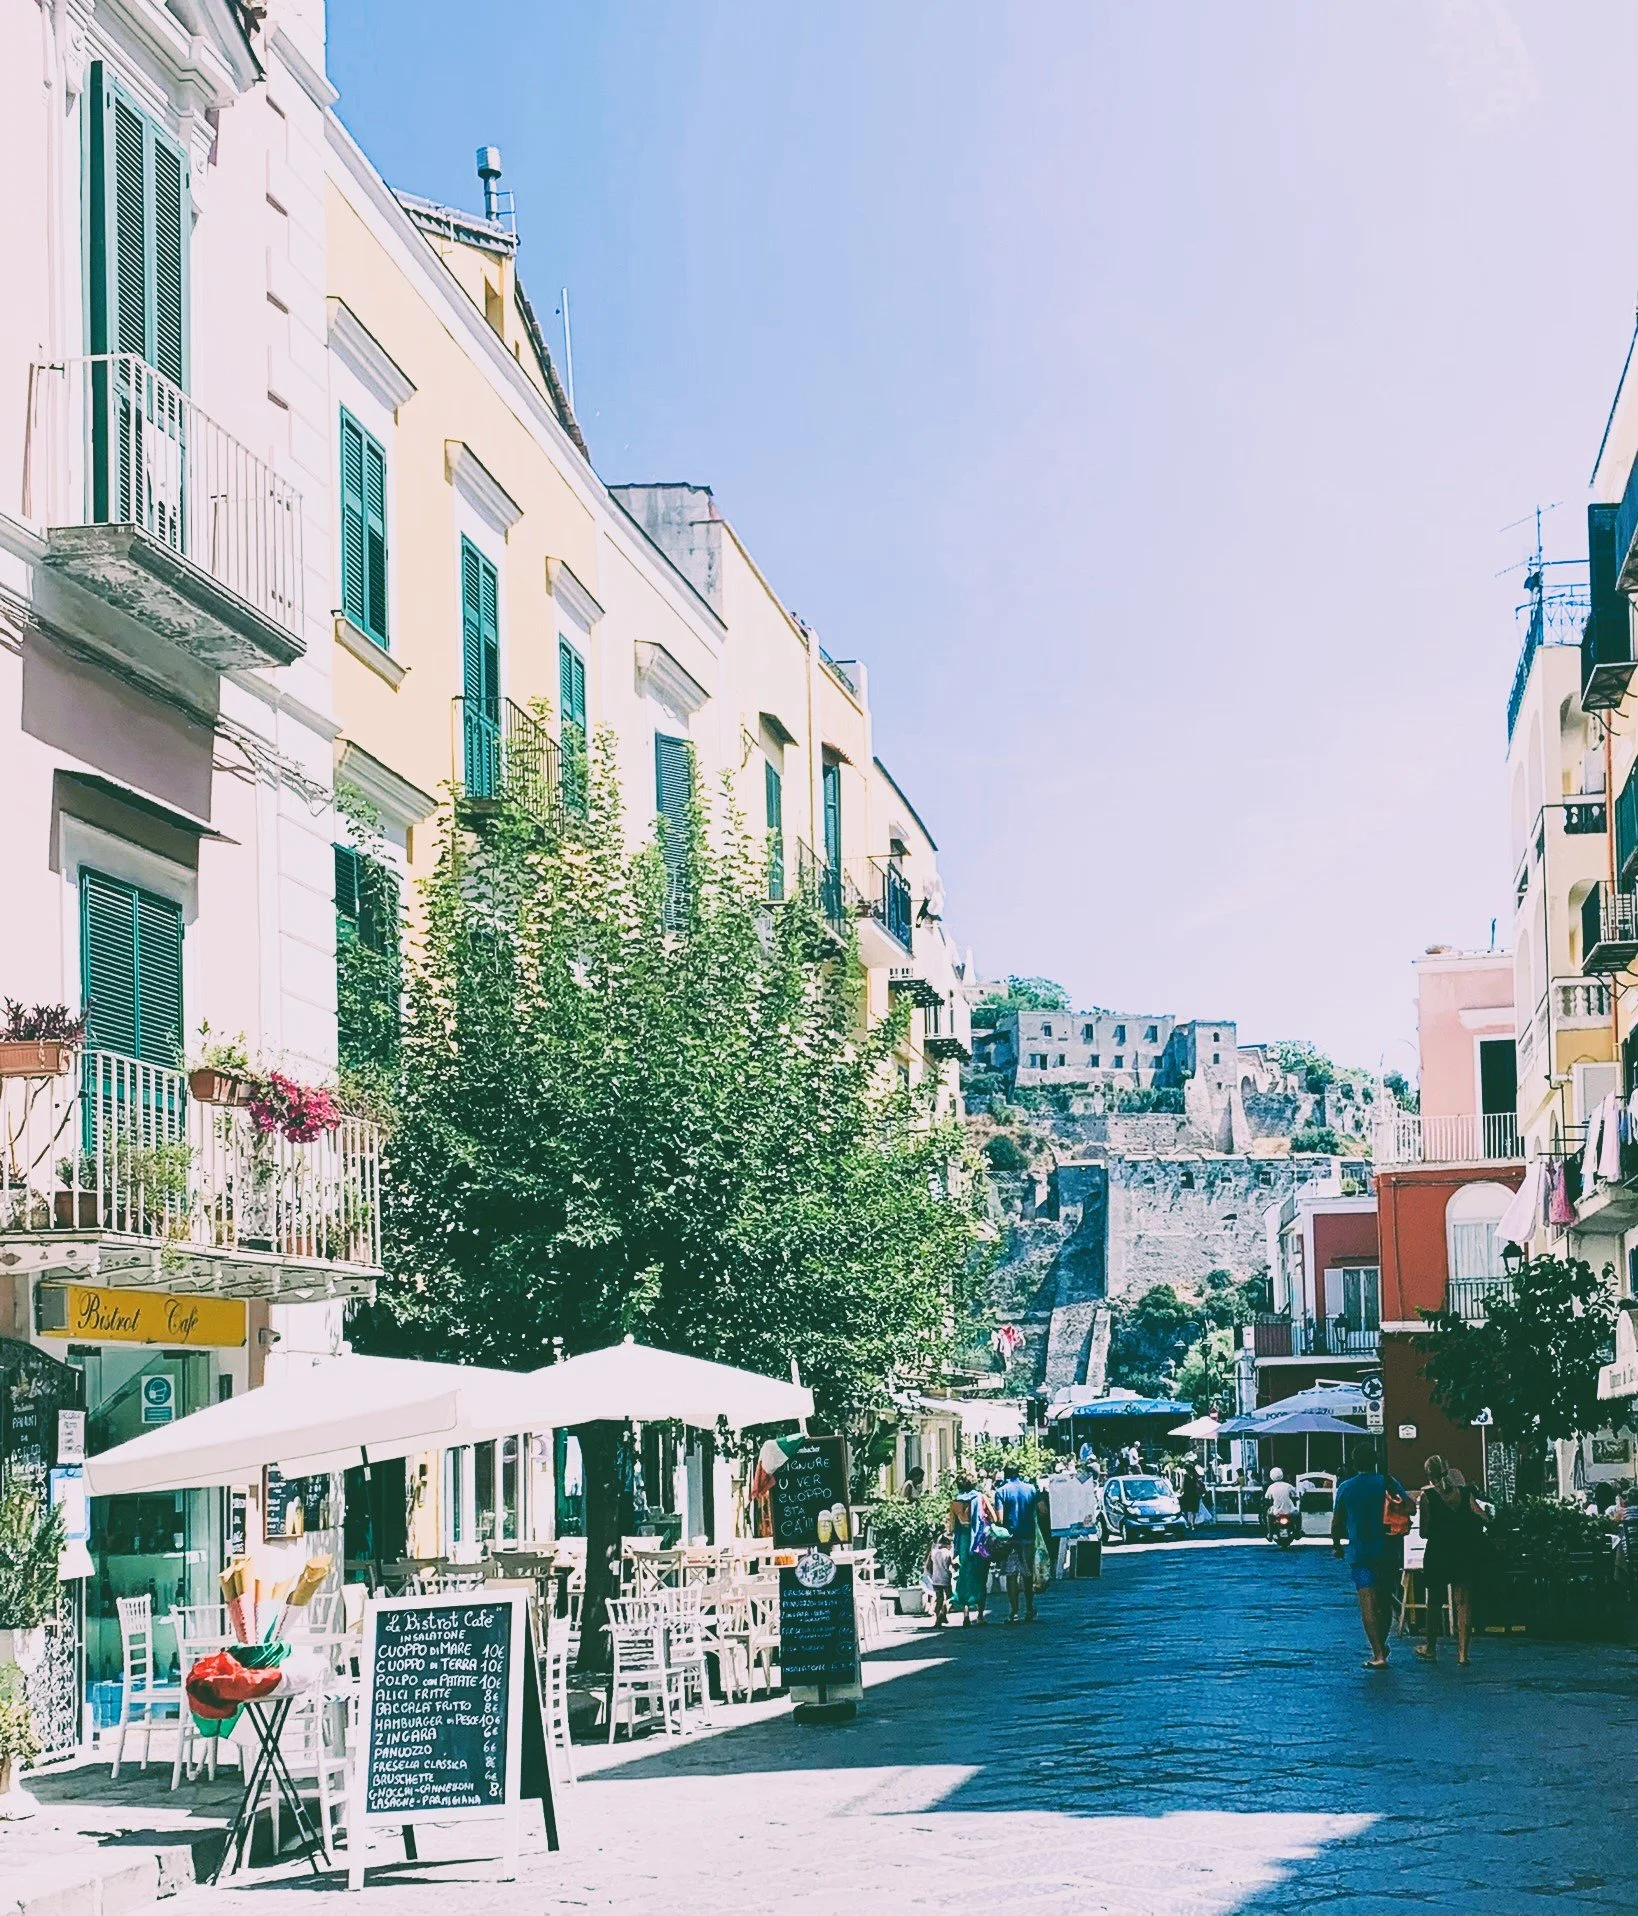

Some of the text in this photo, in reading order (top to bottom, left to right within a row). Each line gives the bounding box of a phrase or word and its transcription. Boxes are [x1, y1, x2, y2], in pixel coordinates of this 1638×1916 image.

[78, 1290, 141, 1331] Bistrot
[797, 1474, 822, 1488] VER
[778, 1488, 832, 1503] CUOPPO
[784, 1505, 805, 1517] STA
[403, 1610, 459, 1631] Bistrot
[400, 1630, 466, 1643] INSALATONE
[378, 1643, 427, 1658] CUOPPO
[440, 1642, 472, 1656] MARE
[482, 1644, 504, 1659] 10€
[376, 1659, 425, 1673] CUOPPO
[440, 1658, 477, 1671] TERRA
[480, 1660, 502, 1673] 10€
[376, 1674, 418, 1687] POLPO
[440, 1674, 478, 1687] PATATE
[479, 1674, 501, 1690] 10€
[375, 1688, 499, 1702] ALICI FRITTE 8€
[435, 1701, 472, 1712] FRITTO
[483, 1702, 499, 1714] 8€
[375, 1715, 443, 1731] HAMBURGER
[455, 1714, 479, 1726] PESCE
[478, 1714, 501, 1728] 10€
[375, 1725, 499, 1745] ZINGARA 6€
[374, 1740, 497, 1760] PANUOZZO 6€
[373, 1760, 420, 1773] FRESELLA
[424, 1759, 468, 1770] CLASSICA
[373, 1771, 498, 1787] BRUSCHETTE 6€
